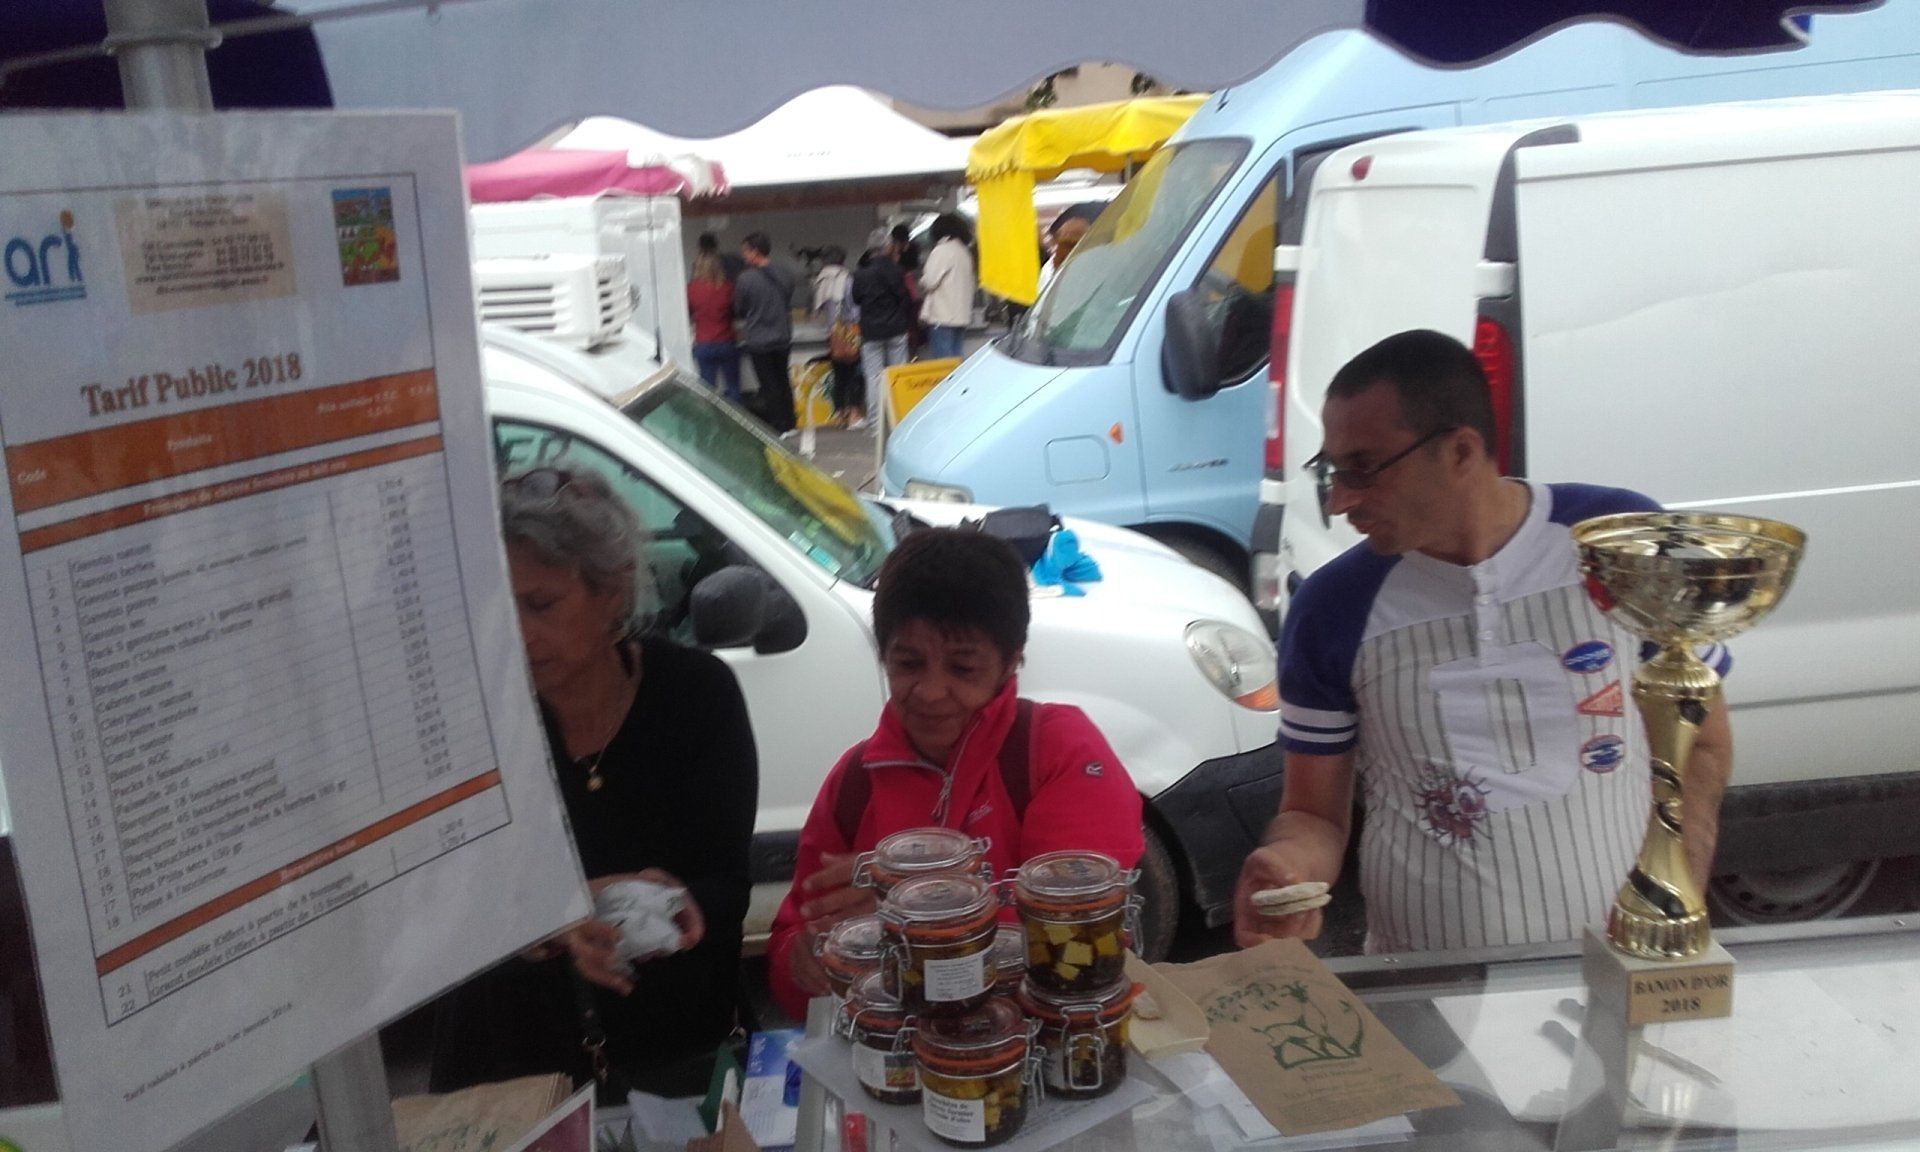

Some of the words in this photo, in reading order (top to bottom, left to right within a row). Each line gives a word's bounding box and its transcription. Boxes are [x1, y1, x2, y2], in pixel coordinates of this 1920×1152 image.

[4, 210, 83, 286] ari
[81, 376, 151, 417] Tarif
[153, 361, 238, 404] Public
[241, 350, 302, 388] 2018
[92, 849, 106, 863] 17
[96, 866, 110, 878] 18
[99, 883, 113, 896] 19
[103, 900, 116, 913] 17
[106, 916, 119, 930] 18
[117, 982, 131, 997] 21
[1634, 976, 1688, 994] BANON
[1690, 973, 1729, 990] D'OR
[120, 998, 135, 1013] 22
[1661, 997, 1702, 1013] 2018
